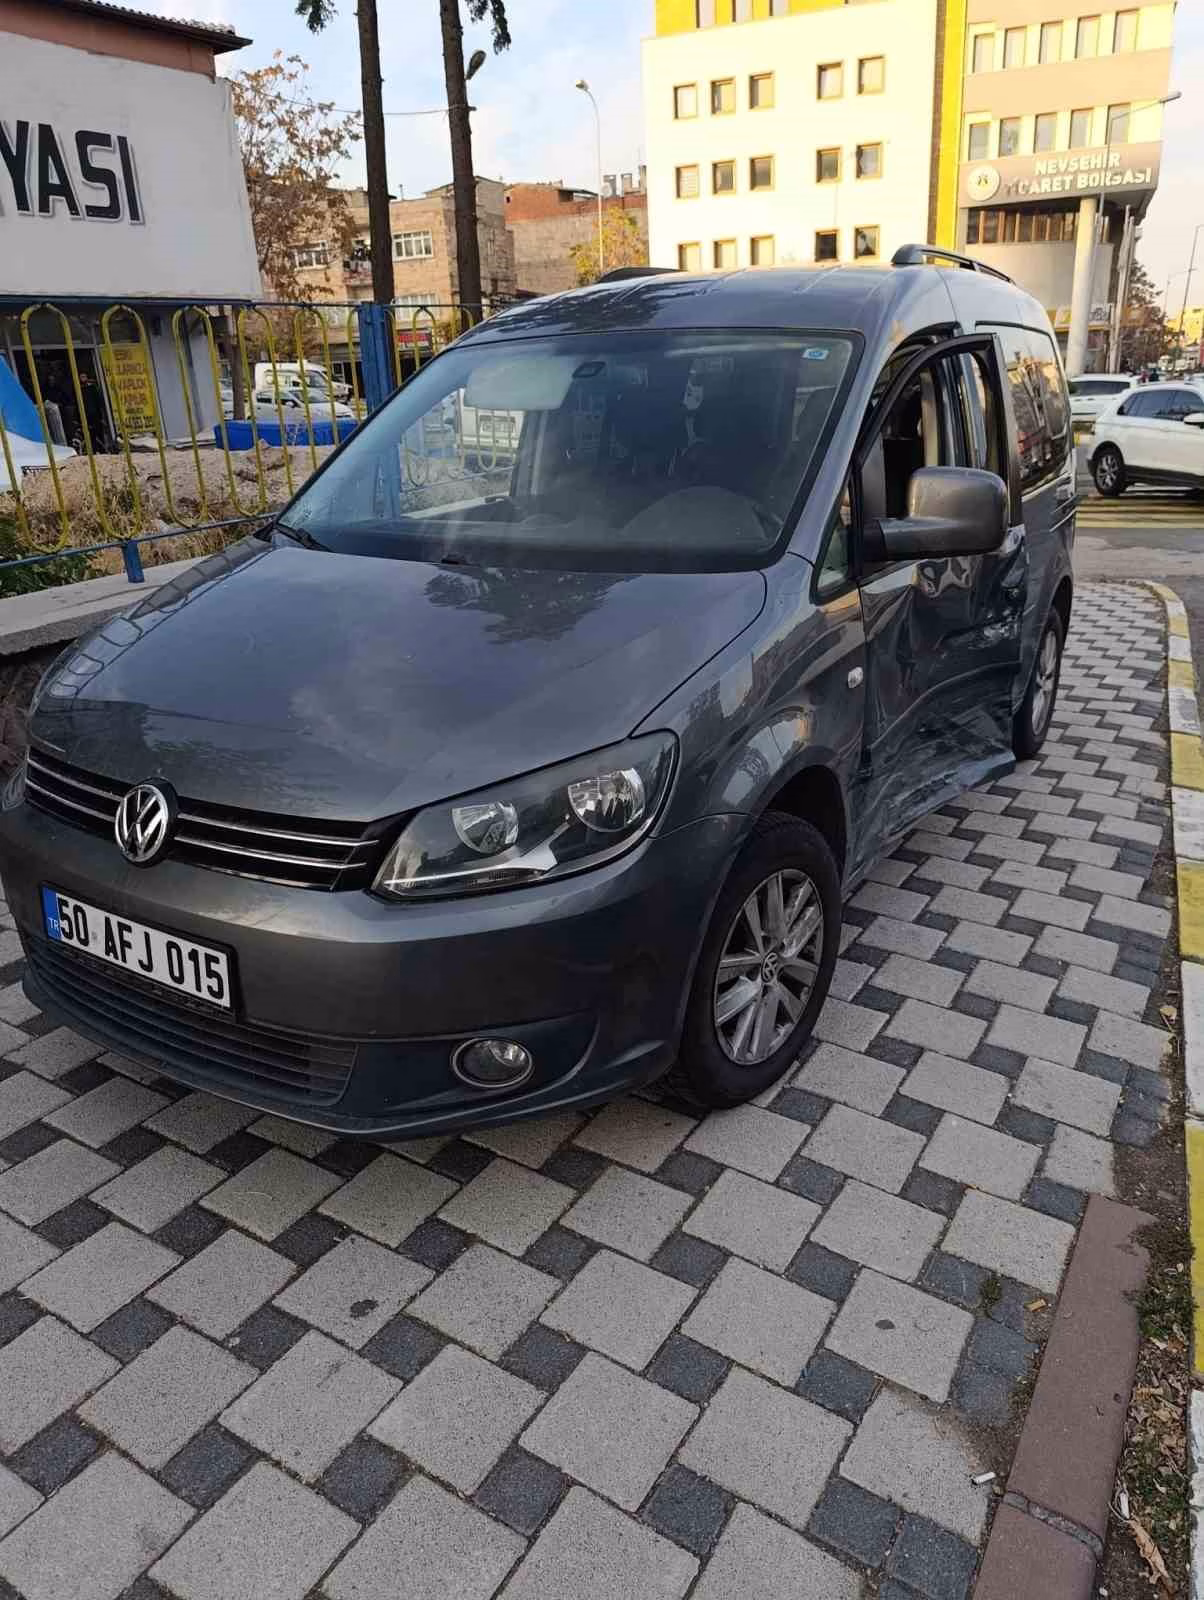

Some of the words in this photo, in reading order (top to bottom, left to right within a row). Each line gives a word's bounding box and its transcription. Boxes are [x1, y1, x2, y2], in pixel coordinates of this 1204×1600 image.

[1076, 167, 1152, 189] BORSASI
[57, 897, 90, 947] 50
[104, 915, 154, 973] AFJ
[166, 940, 225, 1000] 015
